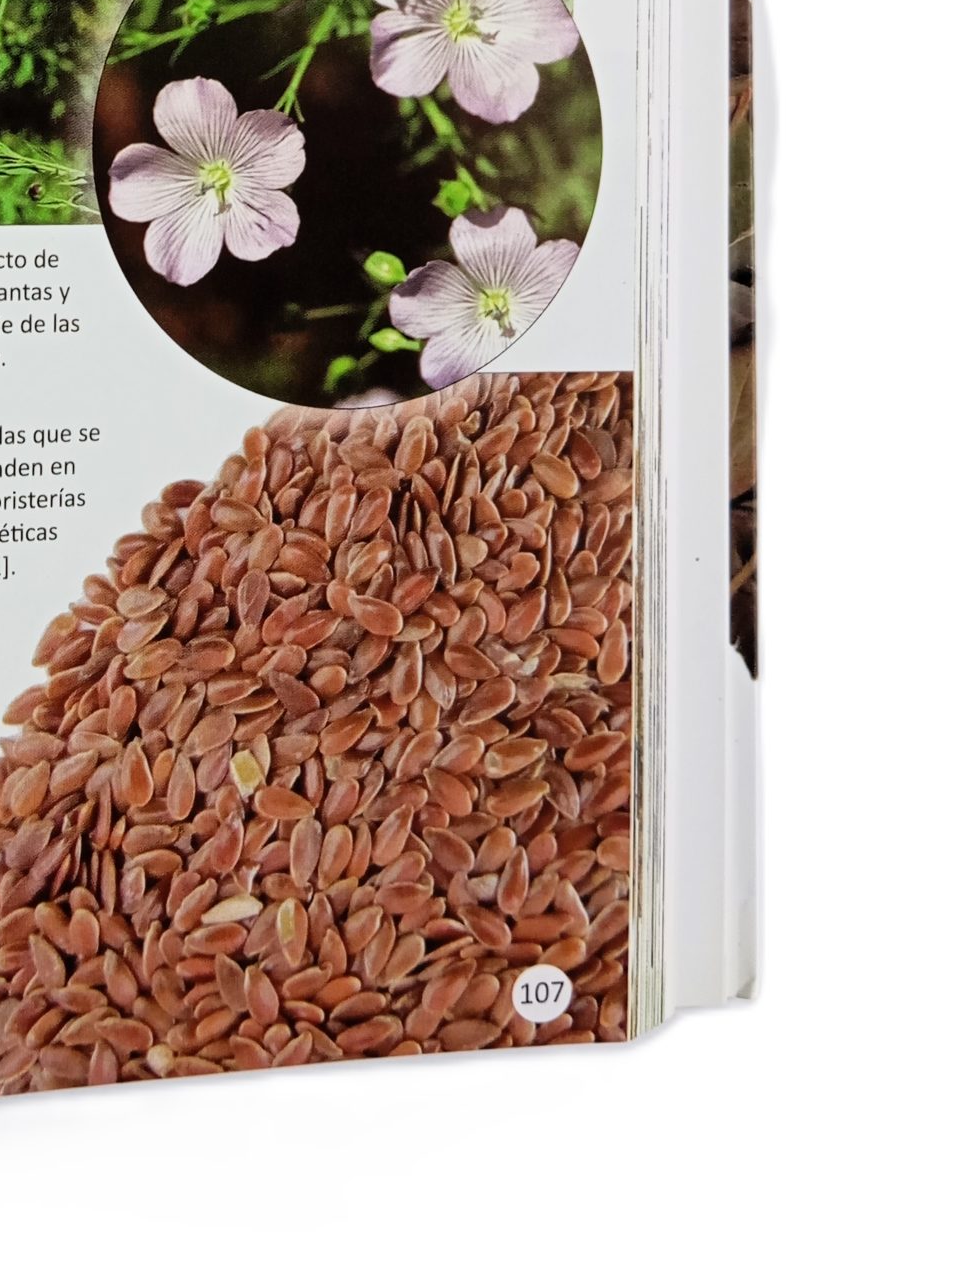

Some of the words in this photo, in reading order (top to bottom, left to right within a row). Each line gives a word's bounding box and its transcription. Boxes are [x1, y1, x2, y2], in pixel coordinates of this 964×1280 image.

[34, 249, 59, 269] de
[59, 286, 70, 305] y
[20, 314, 45, 333] de
[53, 313, 80, 333] las
[33, 428, 72, 448] que
[79, 427, 100, 442] se
[51, 461, 75, 476] en
[520, 980, 565, 1005] 107
